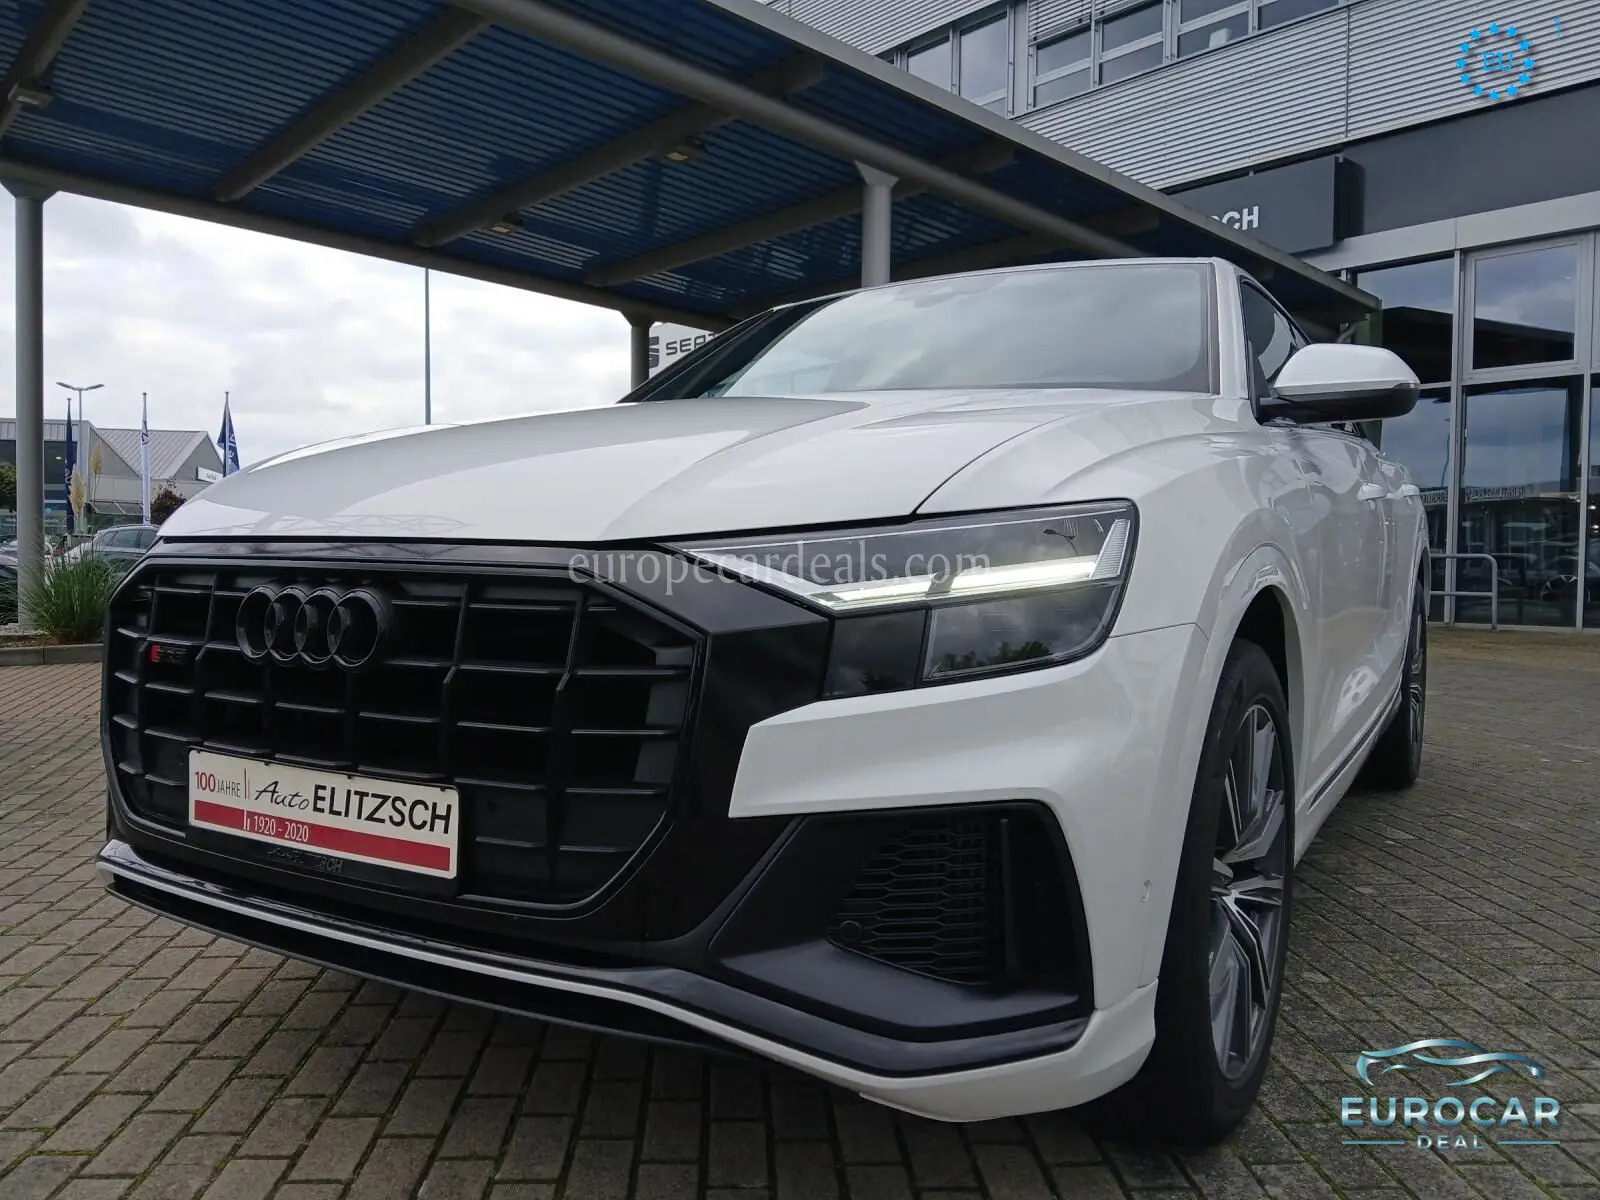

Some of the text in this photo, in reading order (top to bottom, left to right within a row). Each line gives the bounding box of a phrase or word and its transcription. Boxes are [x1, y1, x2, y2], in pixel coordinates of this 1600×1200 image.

[194, 771, 241, 798] 100 JAHRE
[254, 780, 452, 835] Auto ELITZSCH
